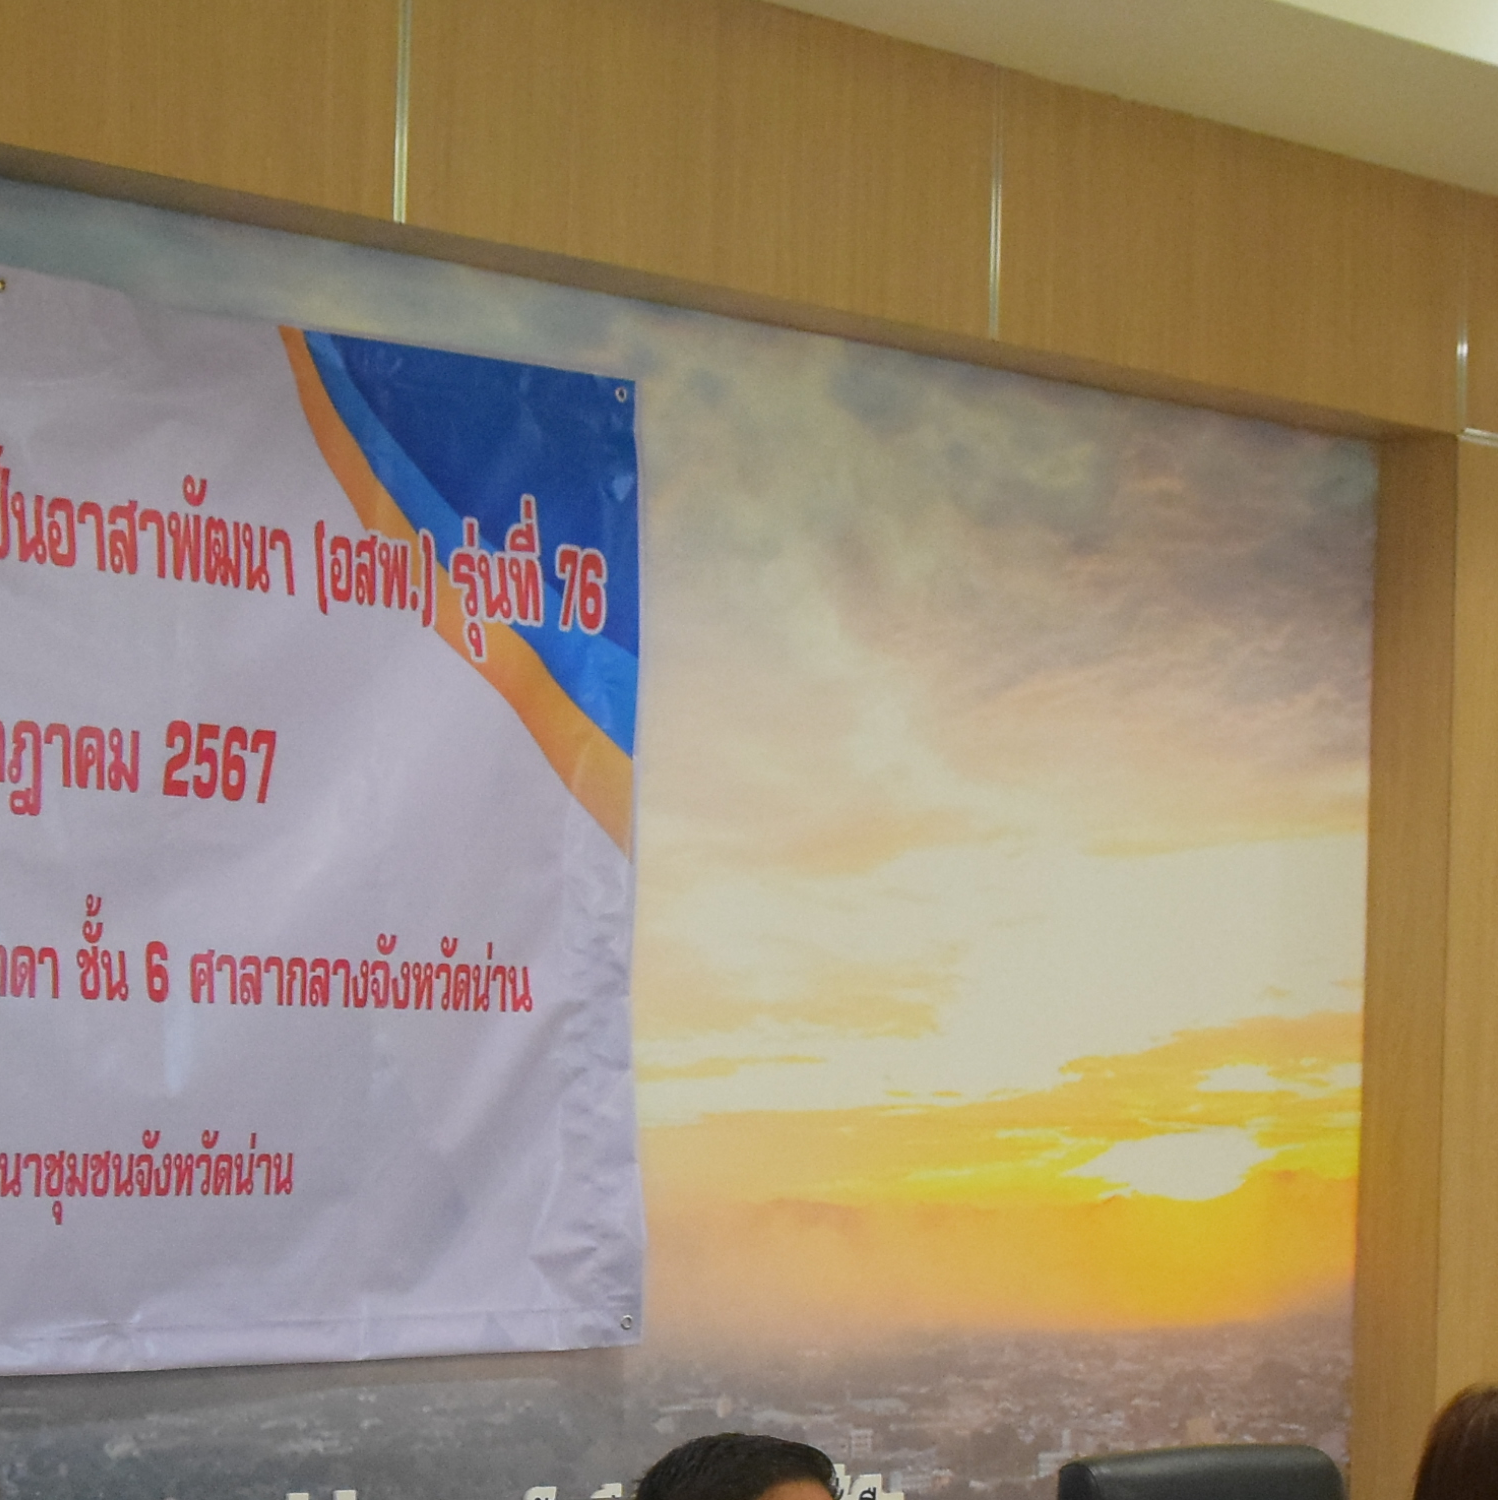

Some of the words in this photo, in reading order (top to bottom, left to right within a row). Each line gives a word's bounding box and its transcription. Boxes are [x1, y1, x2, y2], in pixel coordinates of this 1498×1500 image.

[314, 520, 434, 627] (อสพ.)
[450, 497, 542, 658] รุ่นที่
[558, 548, 606, 632] 76
[162, 720, 278, 804] 2567
[76, 894, 128, 1002] ชั้น
[145, 941, 170, 1003] 6
[189, 933, 534, 1013] ศาลากลางจังหวัดน่าน
